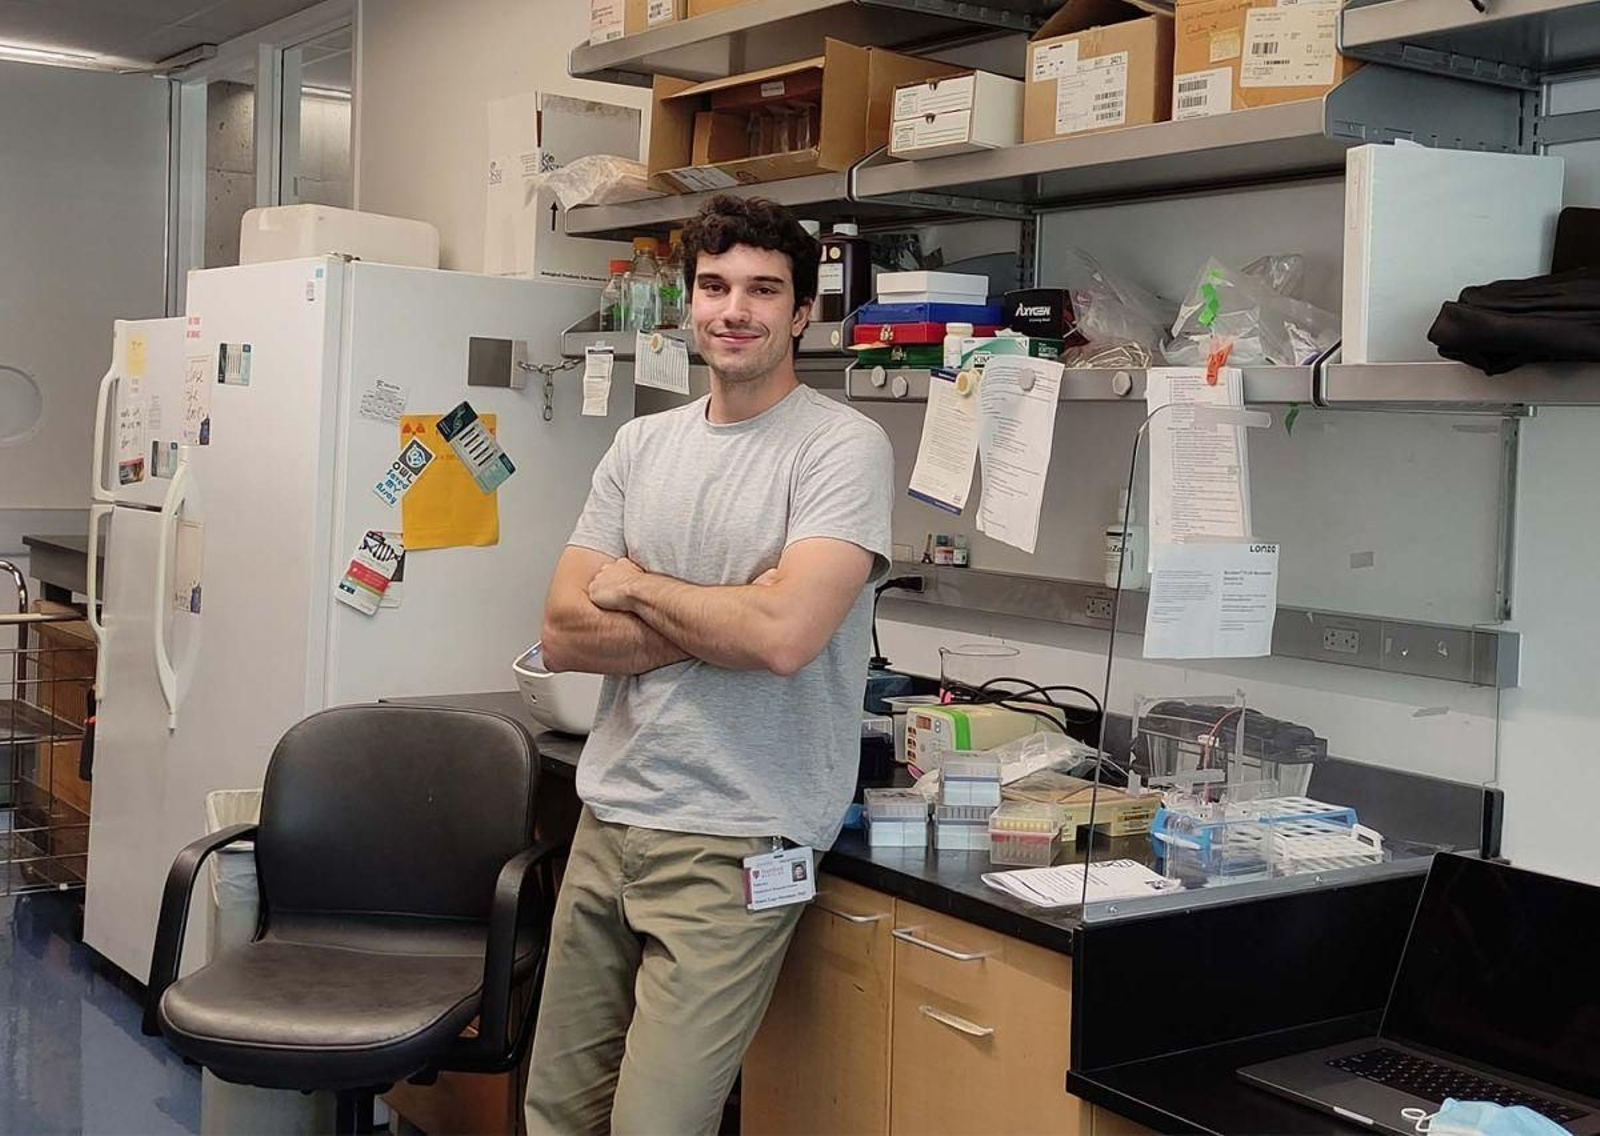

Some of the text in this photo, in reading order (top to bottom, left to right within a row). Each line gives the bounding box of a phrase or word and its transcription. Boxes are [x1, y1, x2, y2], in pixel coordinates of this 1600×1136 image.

[386, 469, 409, 490] Saved
[393, 462, 413, 484] OWL
[375, 483, 397, 504] Array
